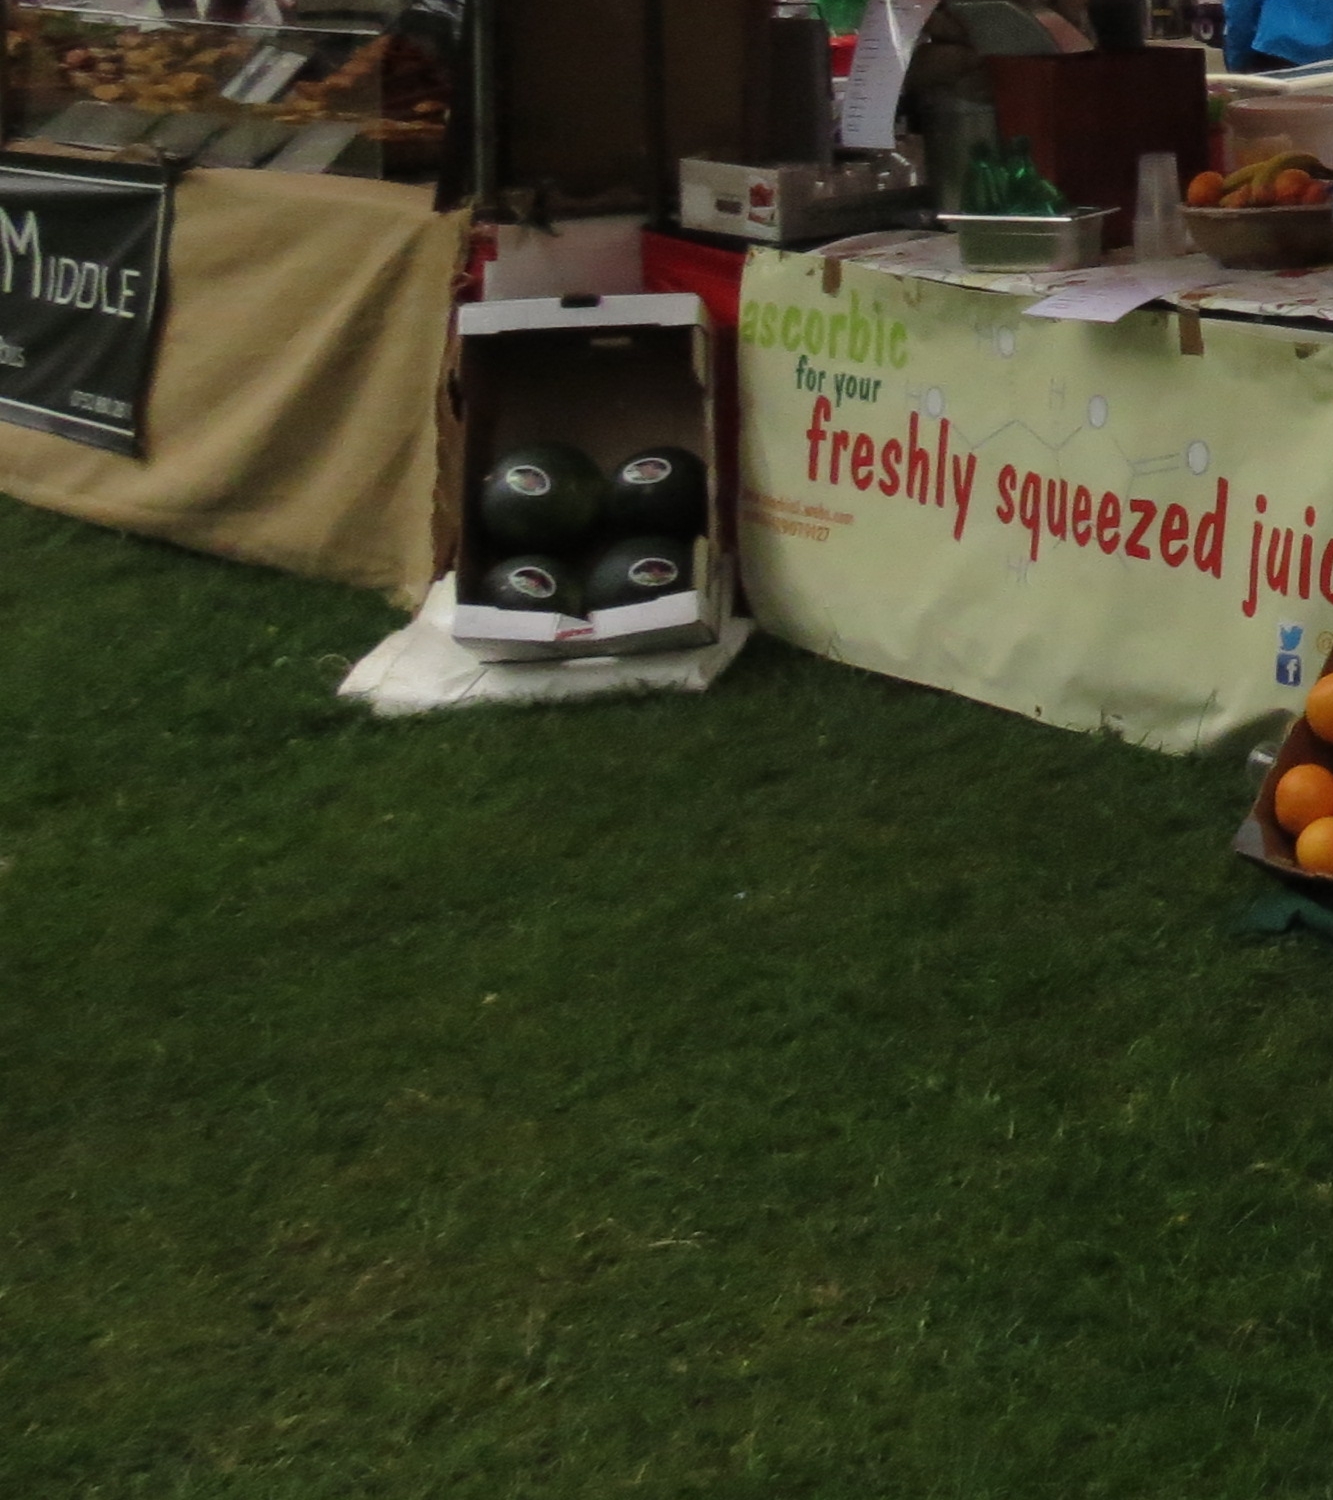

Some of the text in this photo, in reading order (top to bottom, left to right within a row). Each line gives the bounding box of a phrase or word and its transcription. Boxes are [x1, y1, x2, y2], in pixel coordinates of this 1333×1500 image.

[0, 206, 141, 319] MIDDLE
[740, 288, 908, 369] ascorbic
[796, 354, 882, 408] for your
[805, 394, 977, 543] freshly
[996, 463, 1229, 581] squeezed
